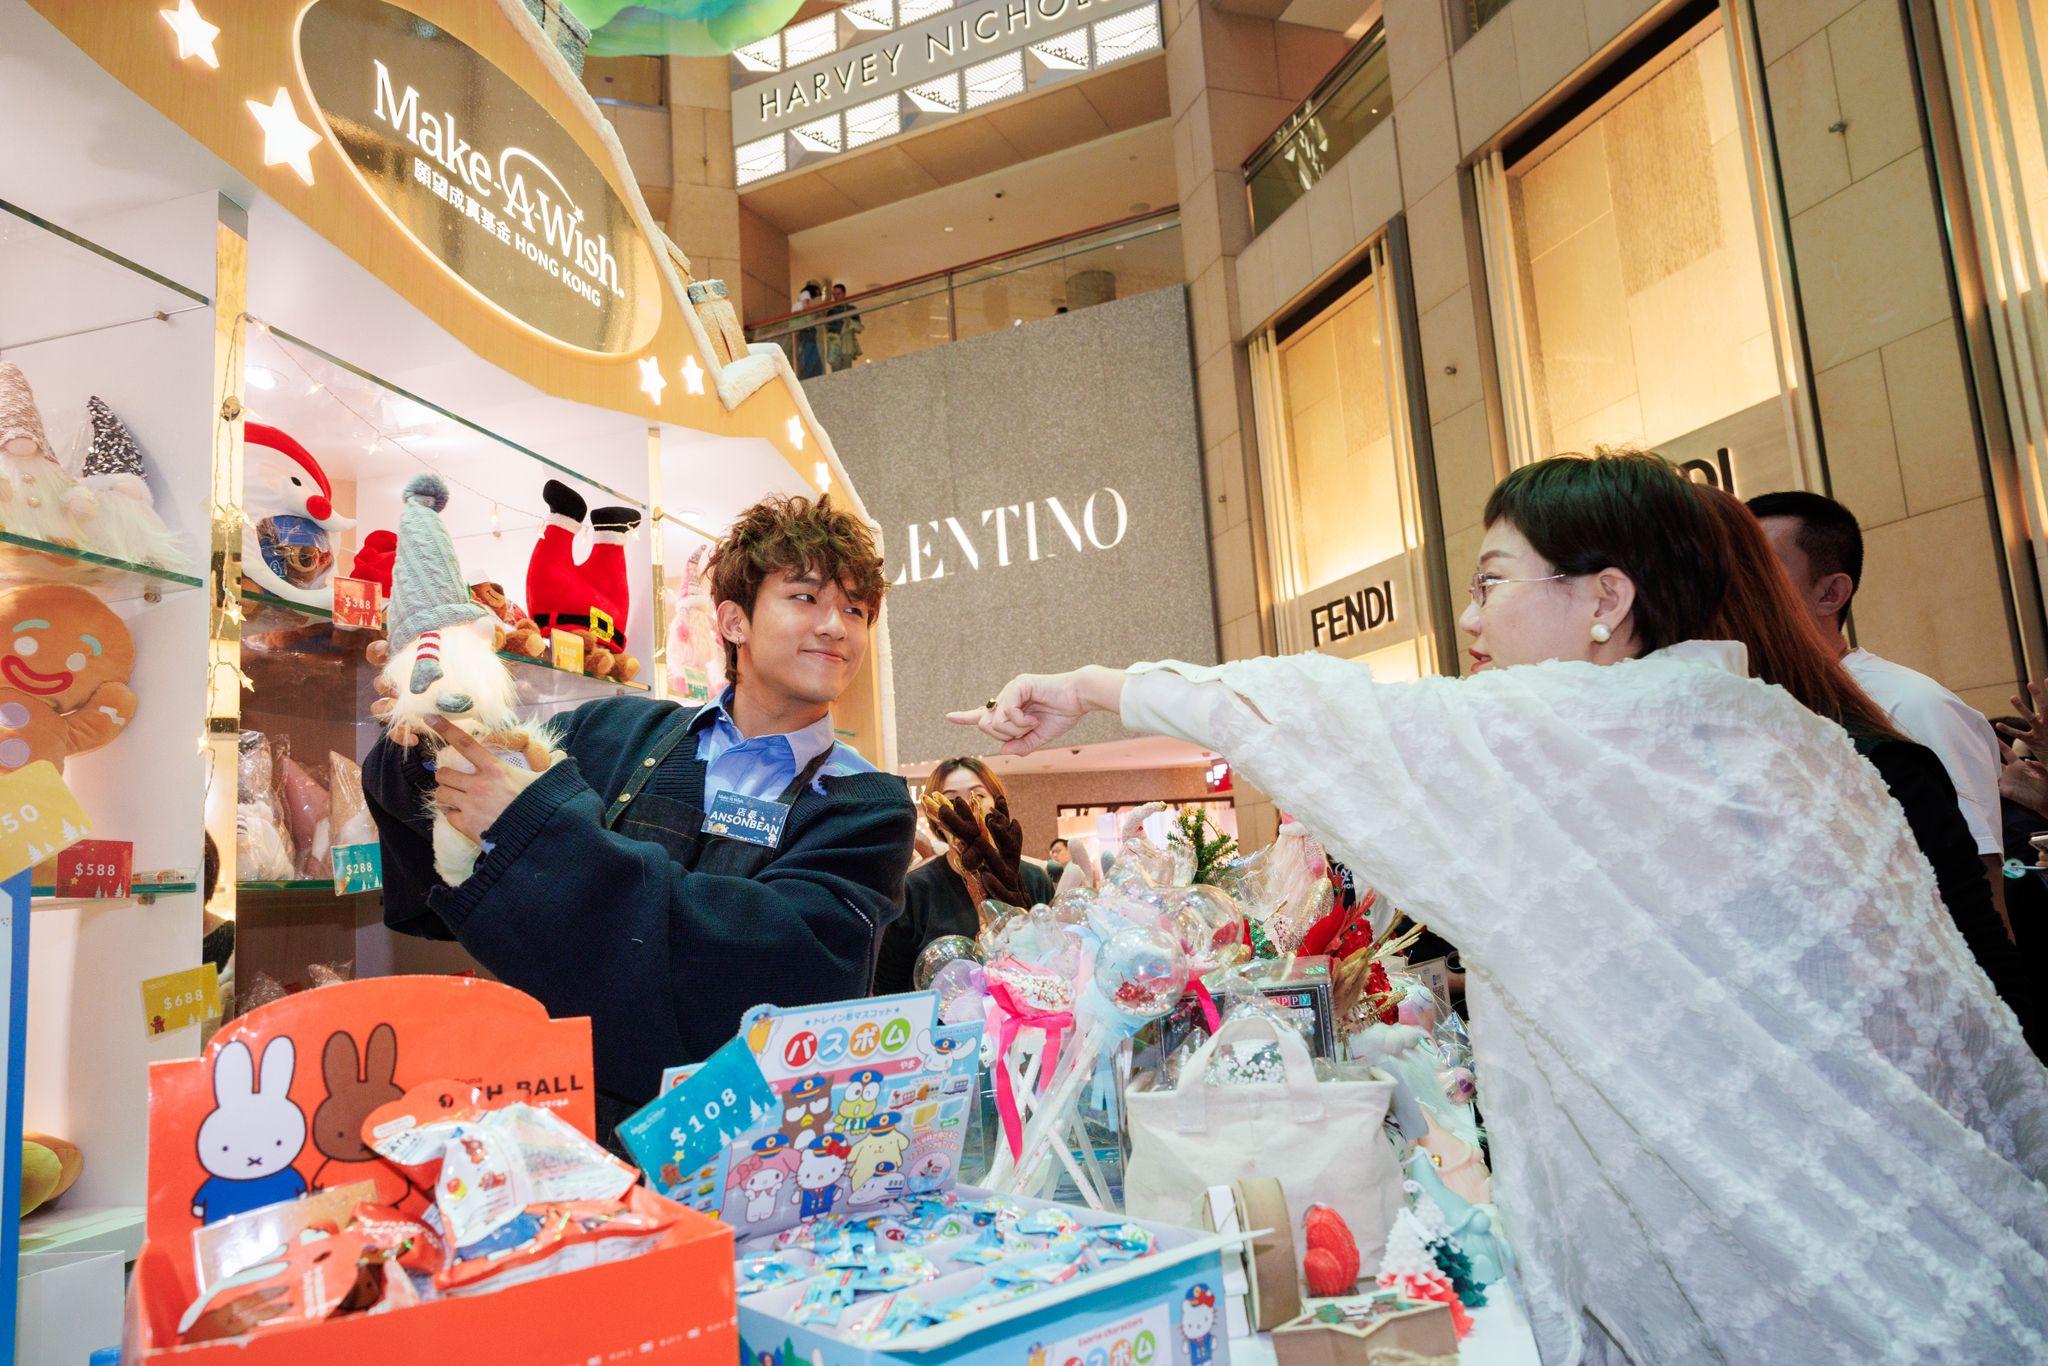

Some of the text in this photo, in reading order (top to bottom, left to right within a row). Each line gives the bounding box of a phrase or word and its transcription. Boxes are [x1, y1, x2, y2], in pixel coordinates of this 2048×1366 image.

[760, 43, 904, 122] HARVEY
[414, 156, 601, 307] 願望成真基金 HONG KONG
[345, 595, 371, 610] $388
[1311, 580, 1396, 647] FENDI
[0, 803, 39, 840] 50
[709, 810, 780, 835] ANSONBEAN
[74, 862, 116, 877] $588
[346, 861, 373, 876] $288
[163, 988, 204, 1011] $688
[785, 1022, 907, 1064] バスボム
[516, 1074, 584, 1097] BALL
[670, 1088, 738, 1147] $108
